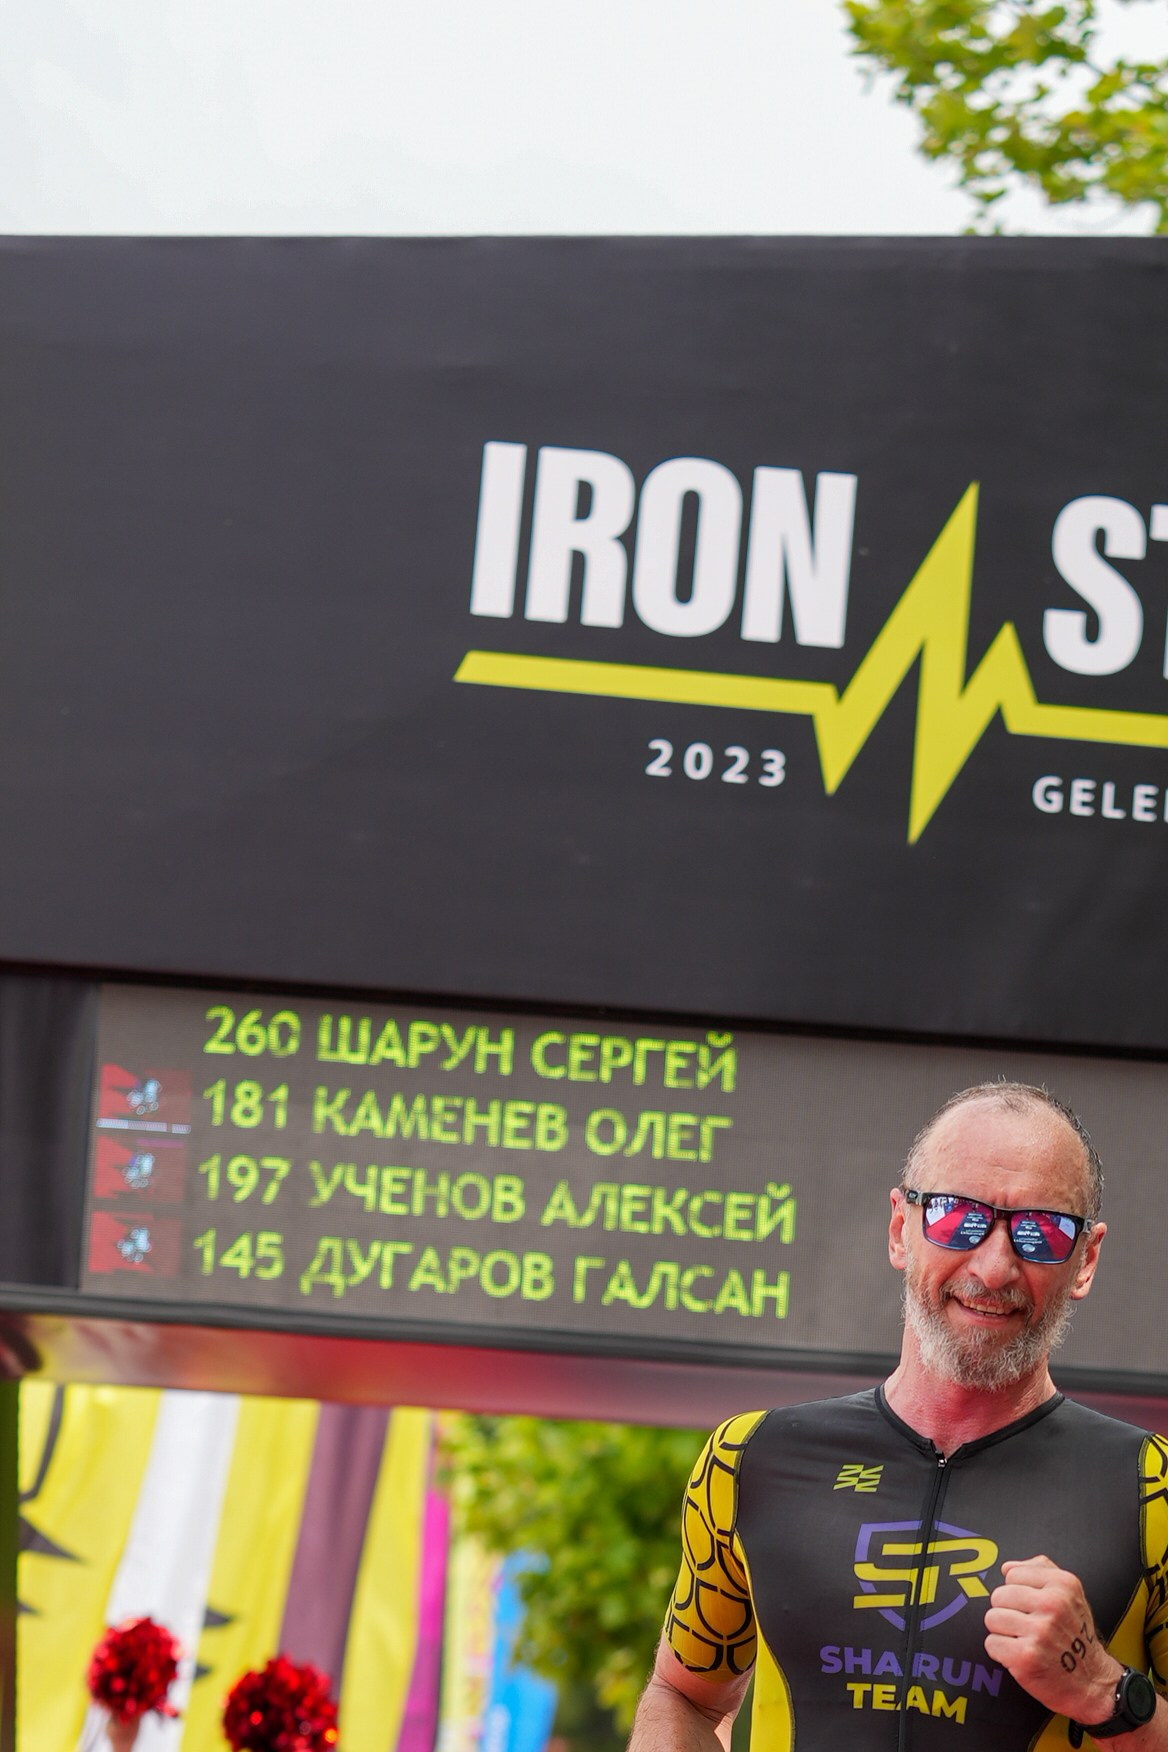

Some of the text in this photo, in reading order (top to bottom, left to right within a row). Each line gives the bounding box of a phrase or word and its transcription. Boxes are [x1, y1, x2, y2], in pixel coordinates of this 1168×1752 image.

[469, 439, 858, 650] IRON
[645, 738, 788, 788] 2023
[204, 1005, 739, 1093] 260 ШАРУН СЕРГЕЙ
[204, 1079, 734, 1163] 181 КАМЕНЕВ ОЛЕГ
[198, 1155, 796, 1245] 197 УЧЕНОВ АЛЕКСЕЙ
[193, 1230, 791, 1319] 145 ДУГАРОВ ГАЛСАН
[845, 1682, 968, 1725] TEAM
